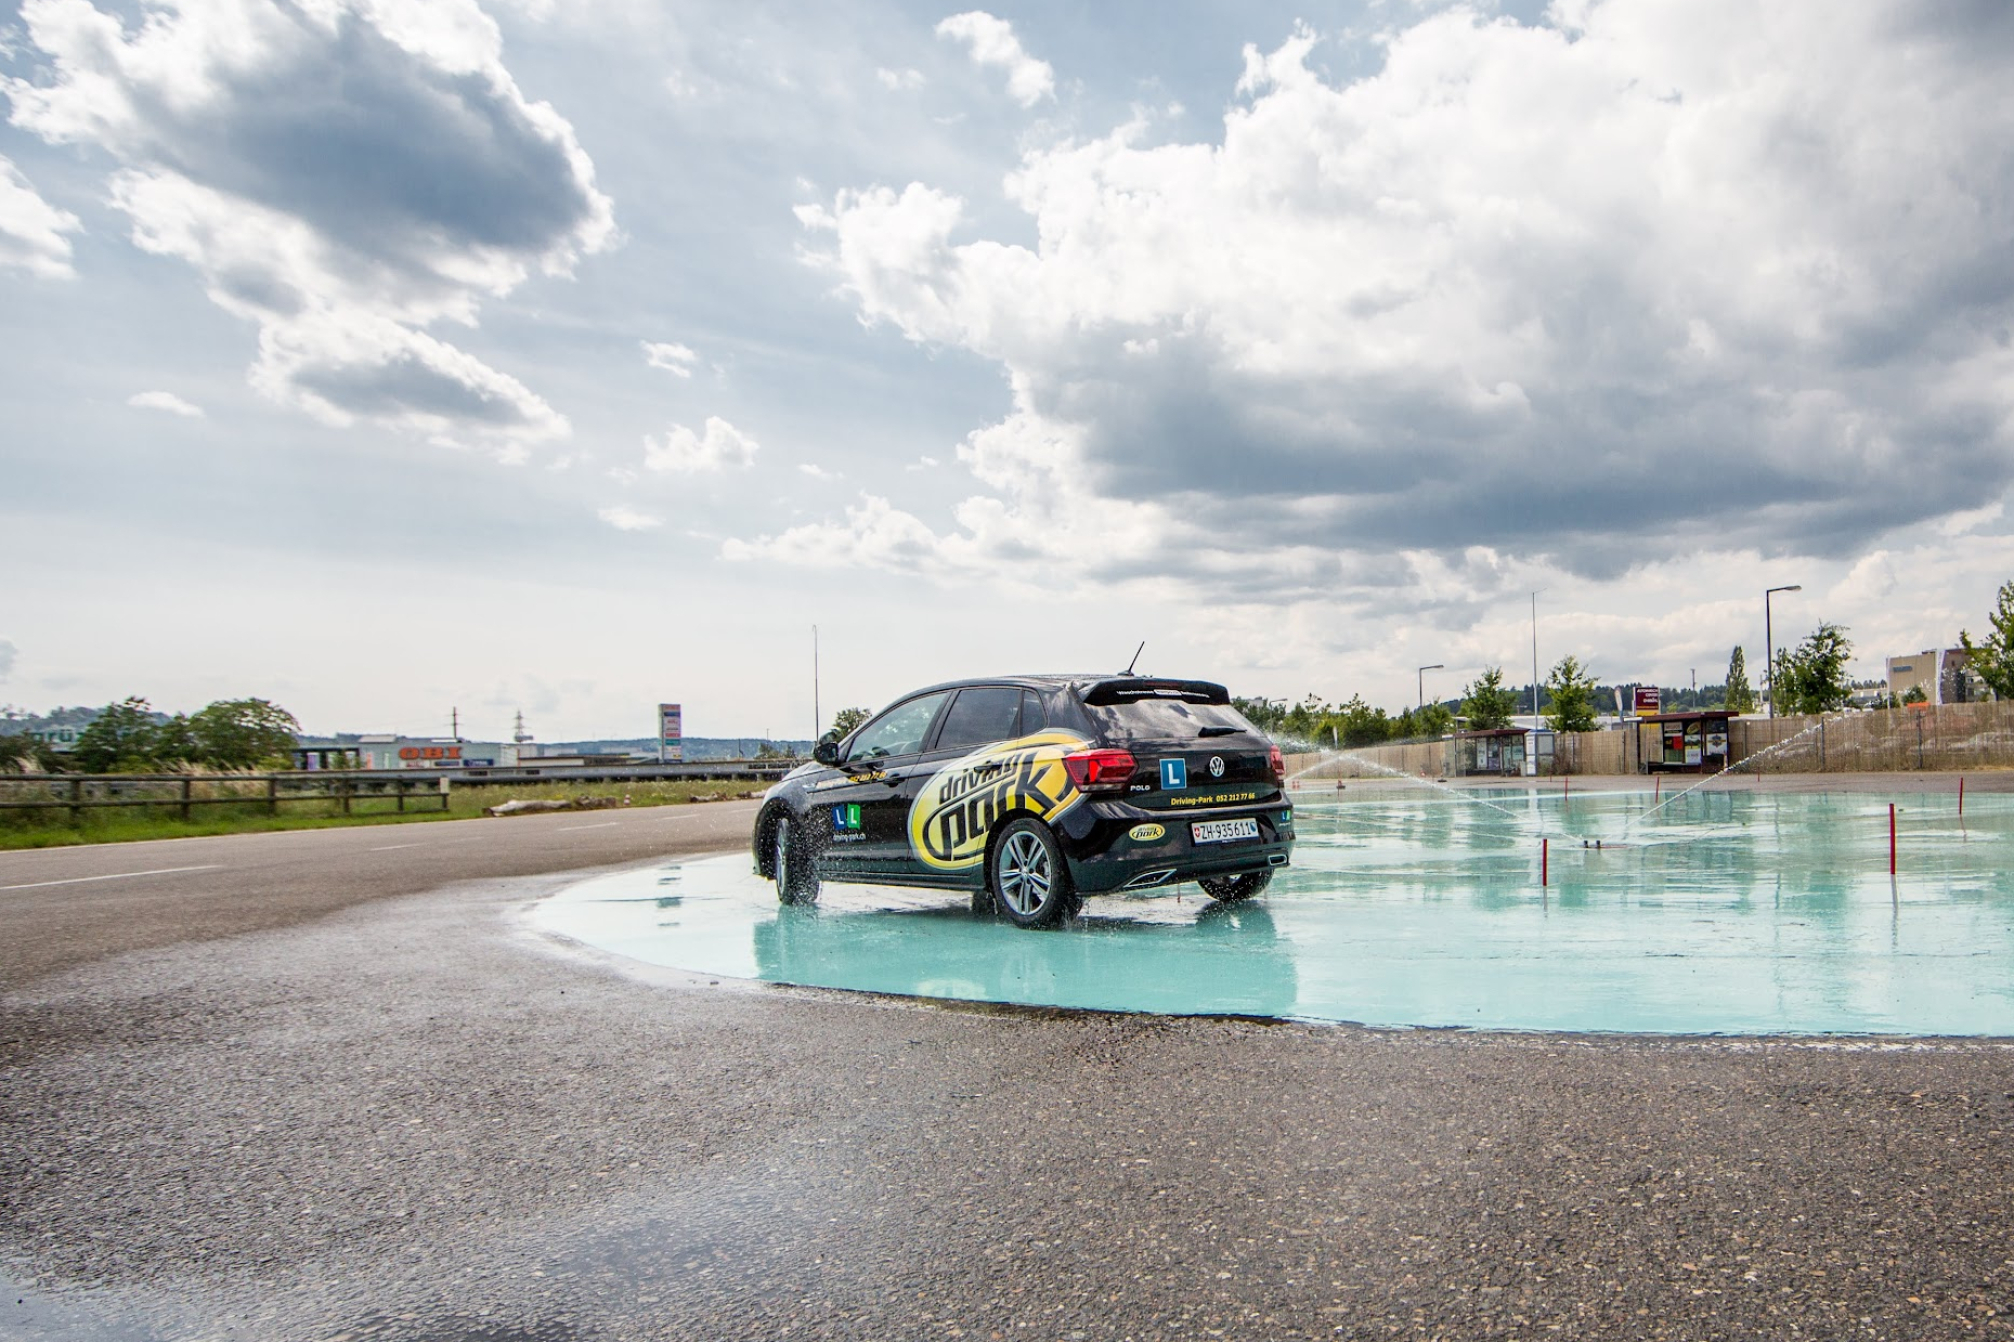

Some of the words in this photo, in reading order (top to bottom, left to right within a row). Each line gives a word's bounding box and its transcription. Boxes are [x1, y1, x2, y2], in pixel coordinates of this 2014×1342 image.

[399, 747, 462, 760] OBI
[940, 751, 1024, 804] driving
[1168, 763, 1180, 785] L
[940, 751, 1059, 861] park
[1170, 795, 1213, 806] Driving-Park
[1216, 794, 1228, 802] 052
[1229, 793, 1240, 801] 212
[1240, 792, 1247, 800] 77
[1137, 827, 1159, 838] park
